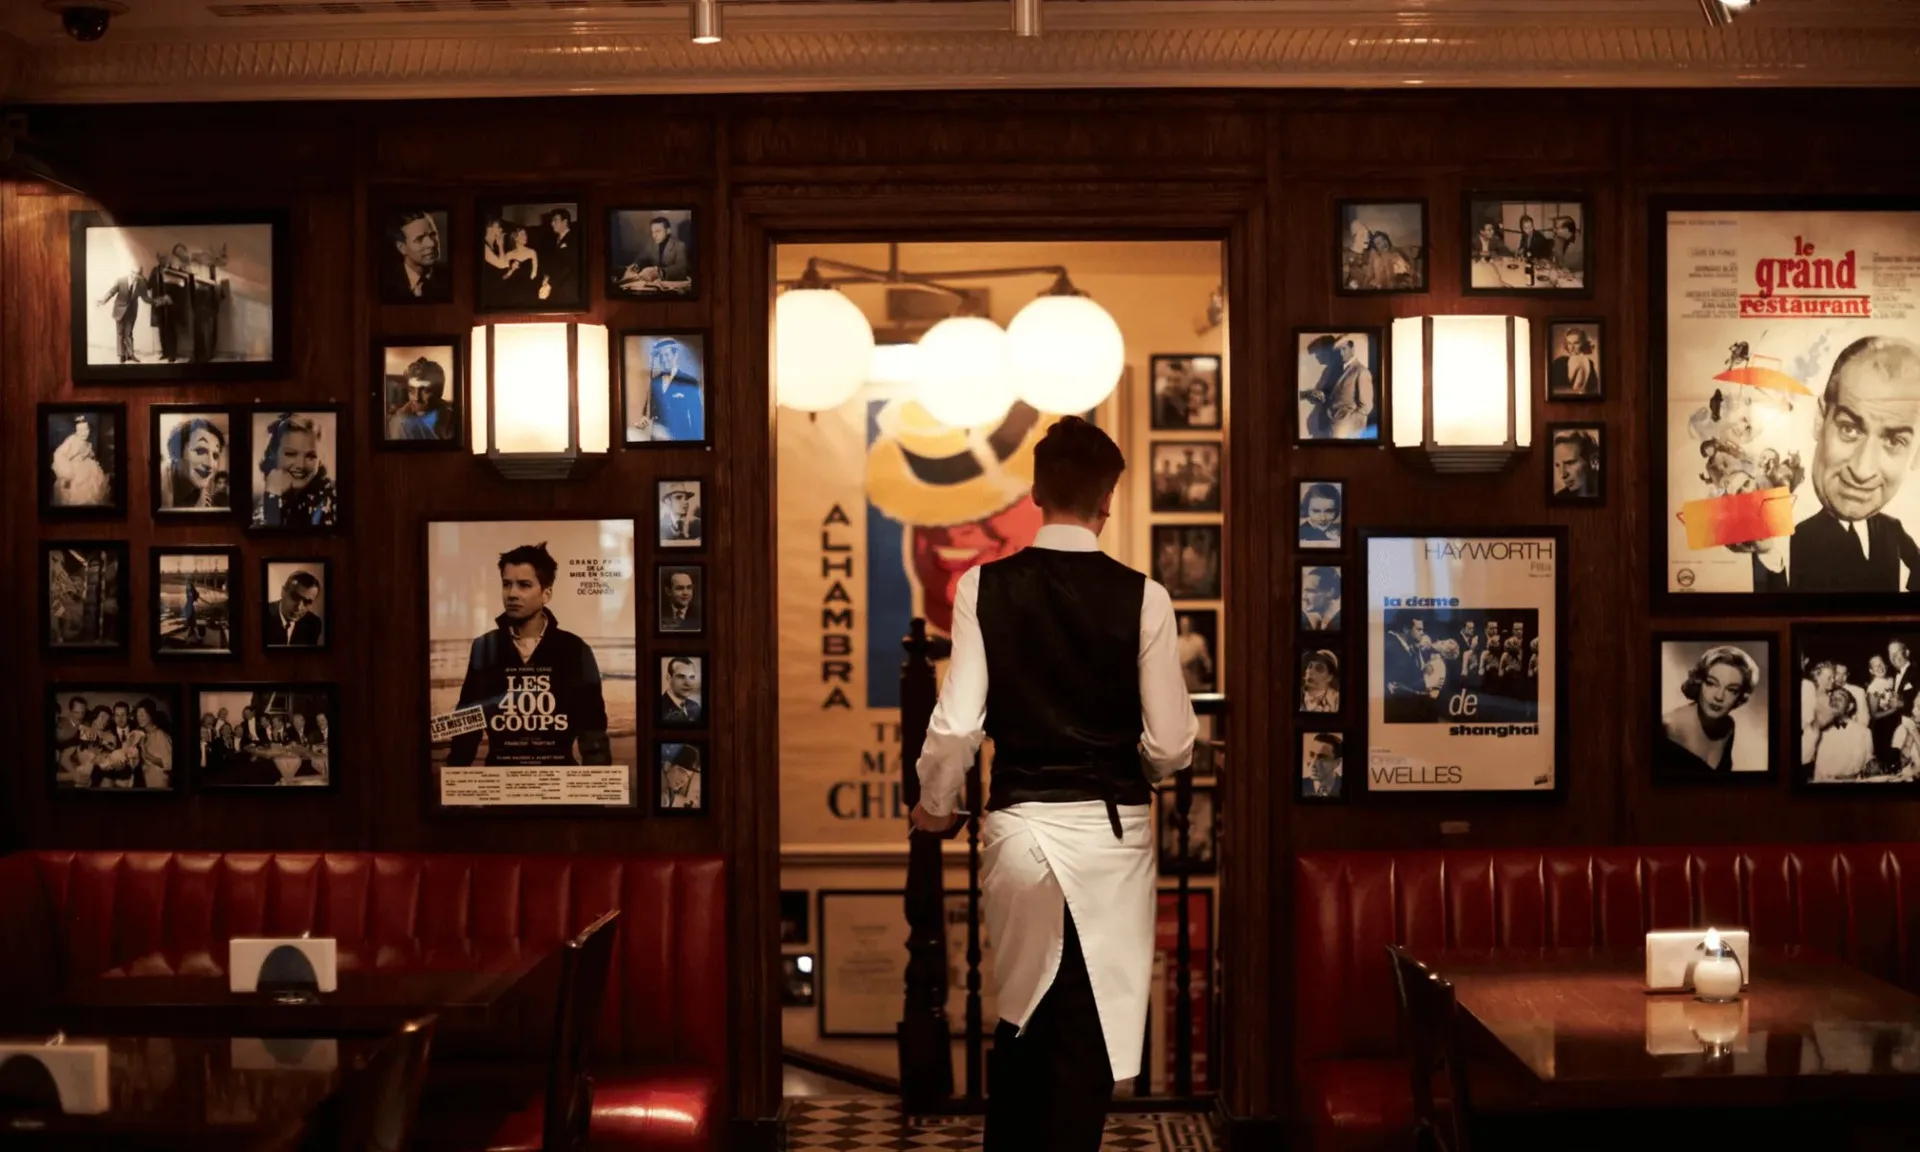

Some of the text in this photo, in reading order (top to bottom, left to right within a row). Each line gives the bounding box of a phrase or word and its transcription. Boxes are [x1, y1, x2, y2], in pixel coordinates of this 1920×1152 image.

[1794, 235, 1815, 256] le
[1755, 250, 1857, 299] grand
[1740, 297, 1872, 316] restaurant
[1424, 542, 1552, 560] HAYWORTH
[821, 503, 853, 709] ALHAMBRA
[1405, 596, 1460, 607] dame
[506, 675, 551, 692] LES
[498, 691, 556, 715] 400
[1449, 688, 1478, 716] de
[431, 722, 447, 734] LES
[490, 714, 569, 732] COUPS
[1449, 724, 1539, 738] shanghai
[1371, 765, 1463, 784] WELLES
